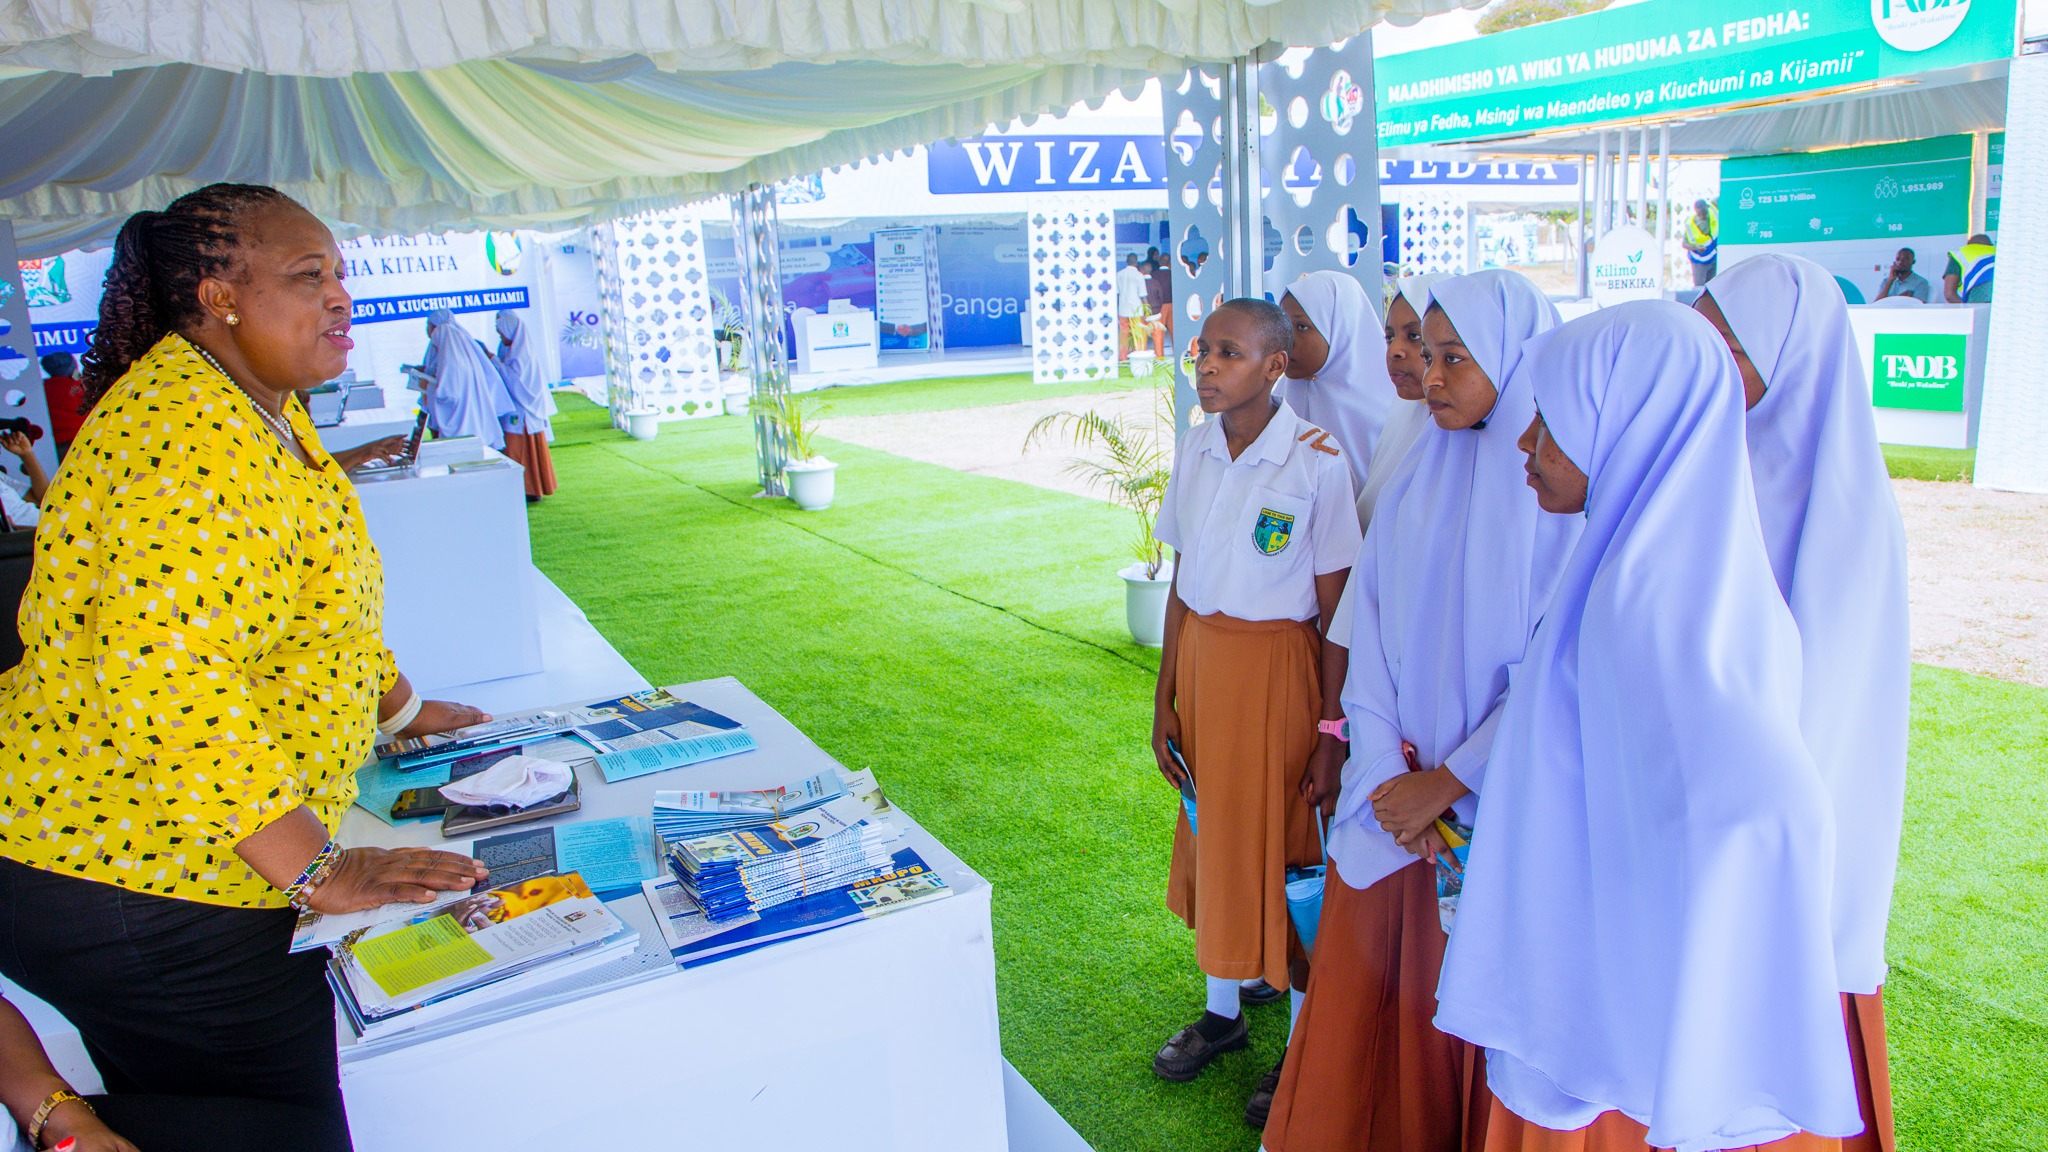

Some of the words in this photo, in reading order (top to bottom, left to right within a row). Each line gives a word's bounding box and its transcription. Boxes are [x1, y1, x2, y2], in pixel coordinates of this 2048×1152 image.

[1388, 69, 1493, 103] MAADHIMISHO
[1496, 65, 1518, 86] YA
[1521, 57, 1562, 81] WIKI
[1566, 53, 1590, 73] YA
[1595, 33, 1682, 69] HUDUMA
[1686, 27, 1717, 51] ZA
[1723, 10, 1810, 46] FEDHA:
[1413, 119, 1428, 134] ya
[1431, 112, 1472, 132] Fedha,
[1475, 105, 1520, 127] Msingi
[1523, 106, 1544, 120] wa
[1547, 91, 1630, 119] Maendeleo
[1635, 89, 1655, 111] ya
[1659, 70, 1744, 102] Kiuchumi
[1750, 68, 1774, 88] na
[1902, 182, 1944, 193] 1,953,989
[381, 254, 459, 276] KITAIFA
[1595, 264, 1637, 277] Kilimo
[1608, 278, 1655, 290] BENKIKA
[351, 303, 375, 319] LEO
[378, 300, 396, 316] YA
[397, 294, 463, 313] KIUCHUMI
[464, 293, 481, 308] NA
[483, 290, 525, 306] KIJAMII
[33, 328, 78, 347] IMU
[1882, 354, 1958, 380] TADB
[853, 865, 923, 889] MKOPO
